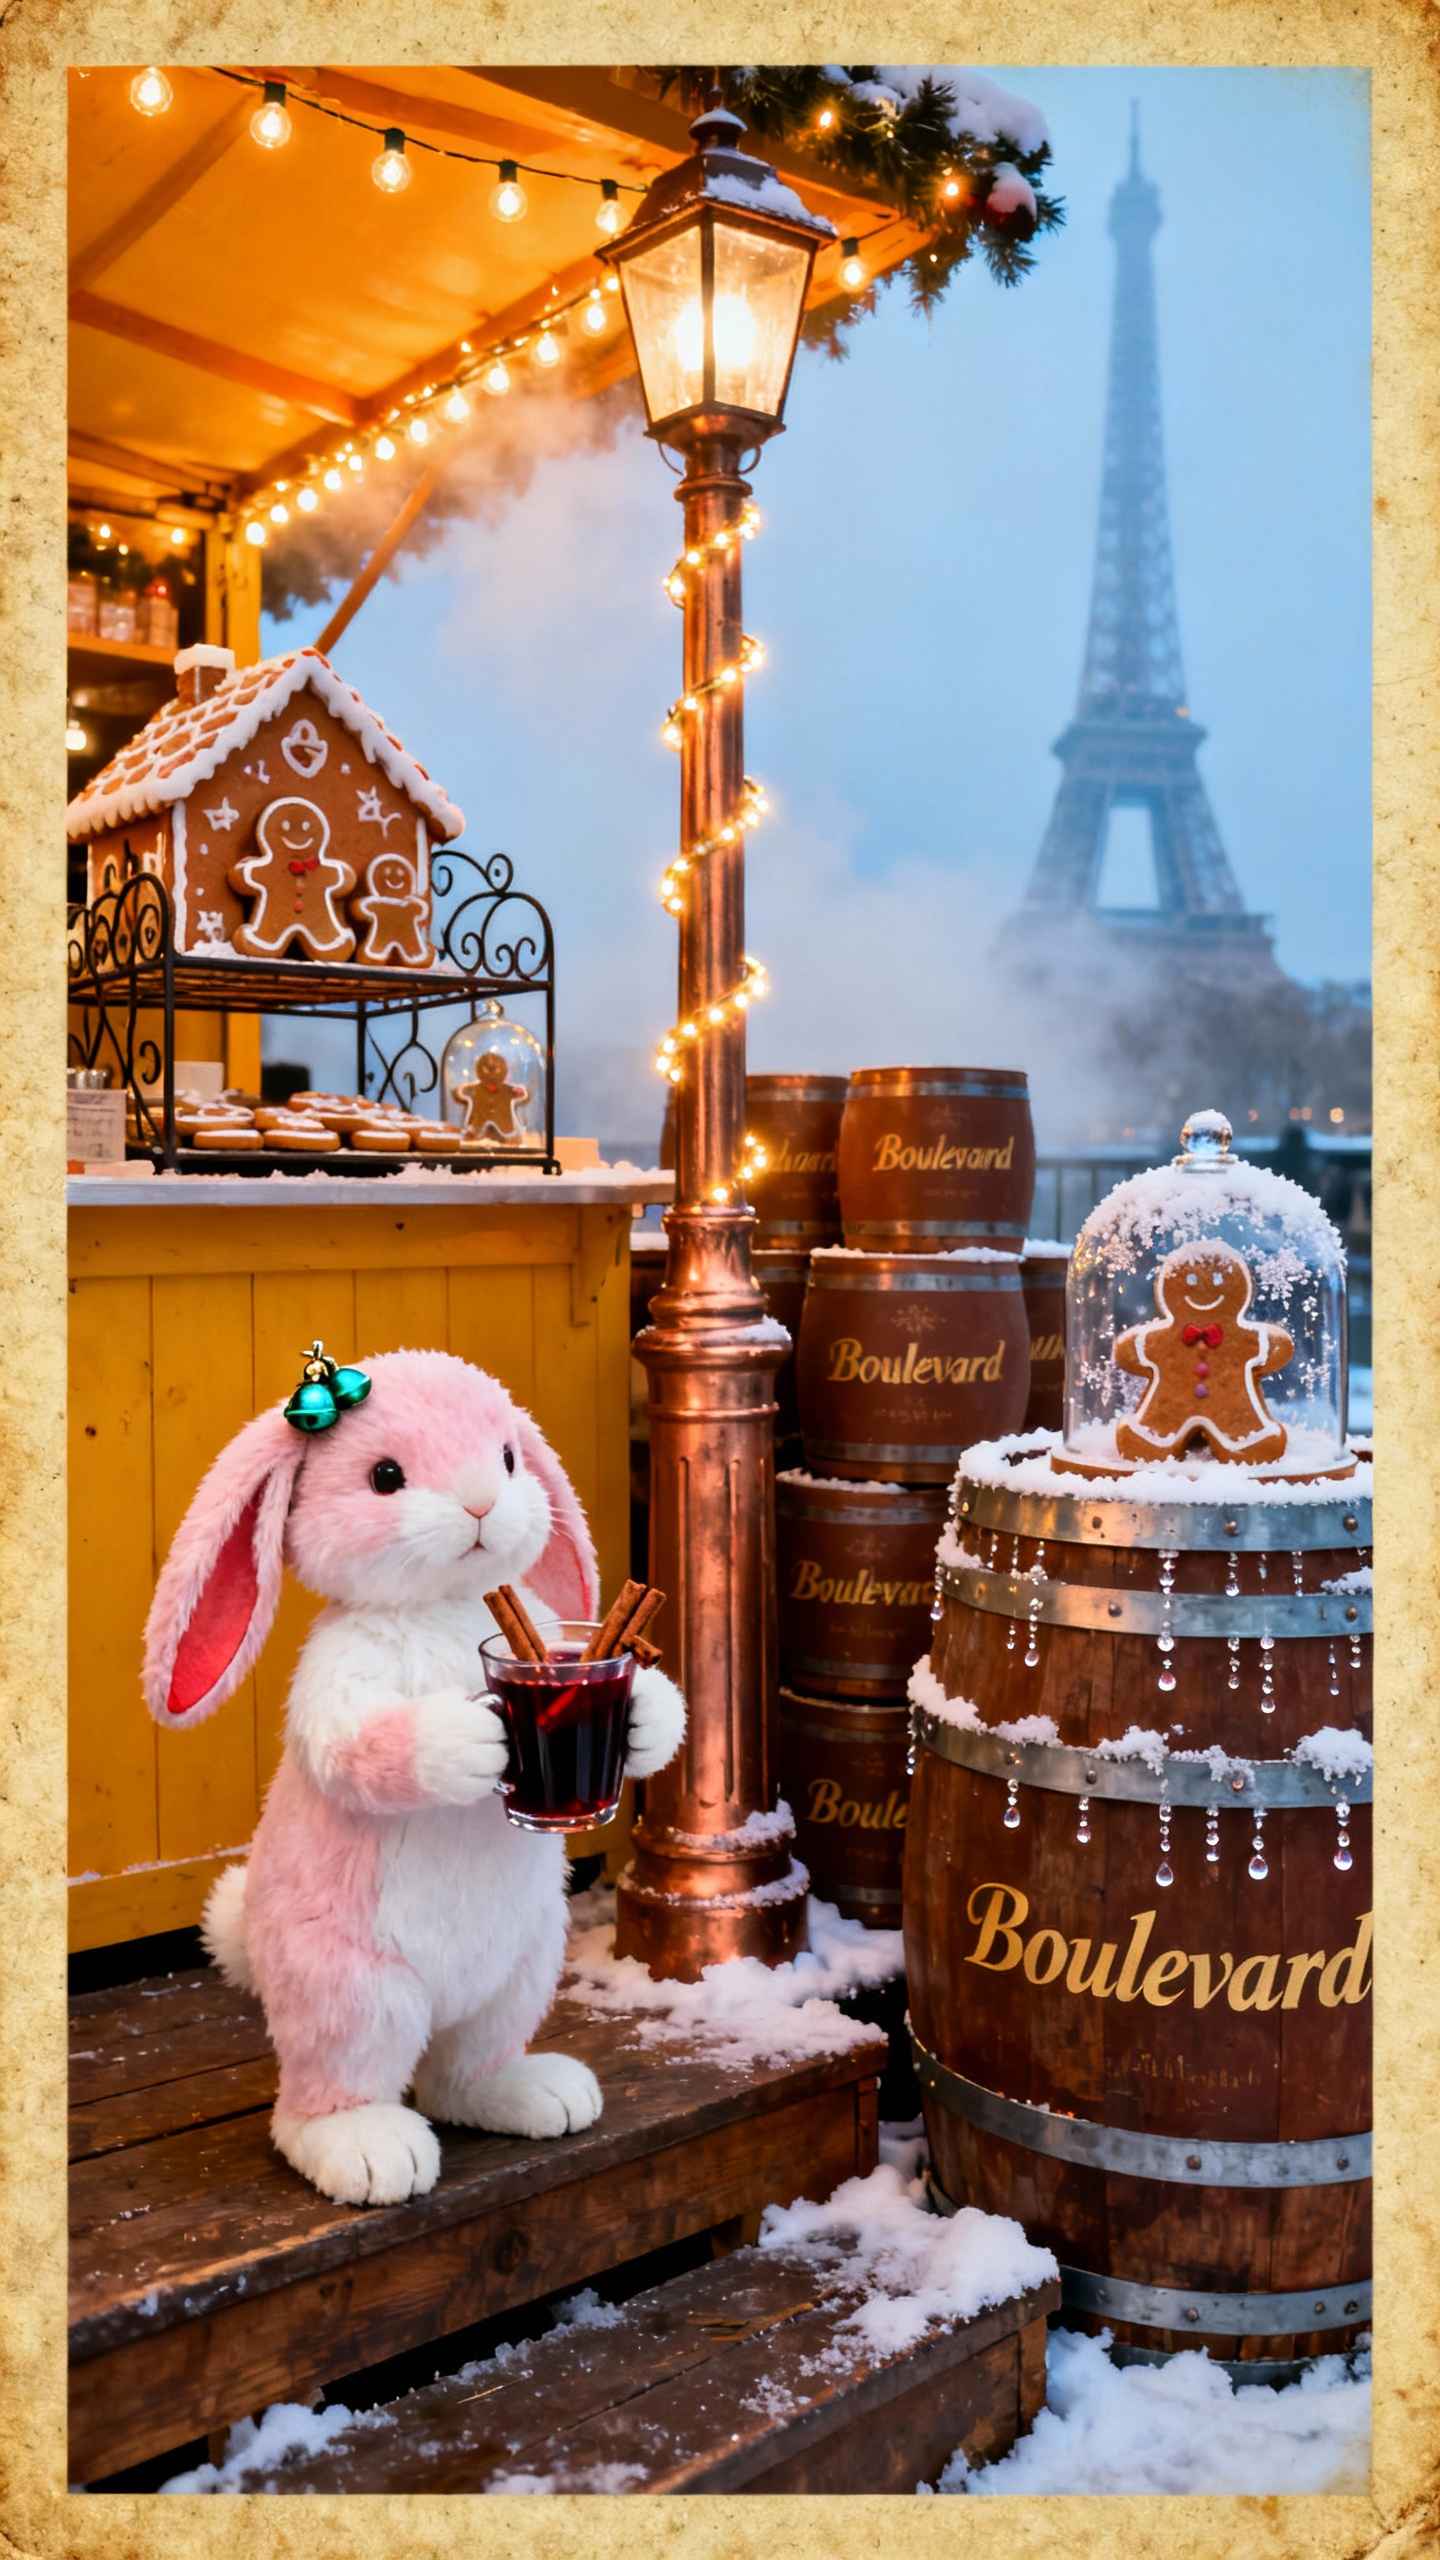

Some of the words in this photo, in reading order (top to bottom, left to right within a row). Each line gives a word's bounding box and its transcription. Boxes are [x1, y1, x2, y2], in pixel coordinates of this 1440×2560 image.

[872, 1134, 1015, 1172] Boulevard
[827, 1338, 1005, 1385] Boulevard
[963, 1882, 1373, 2013] Boulevard
